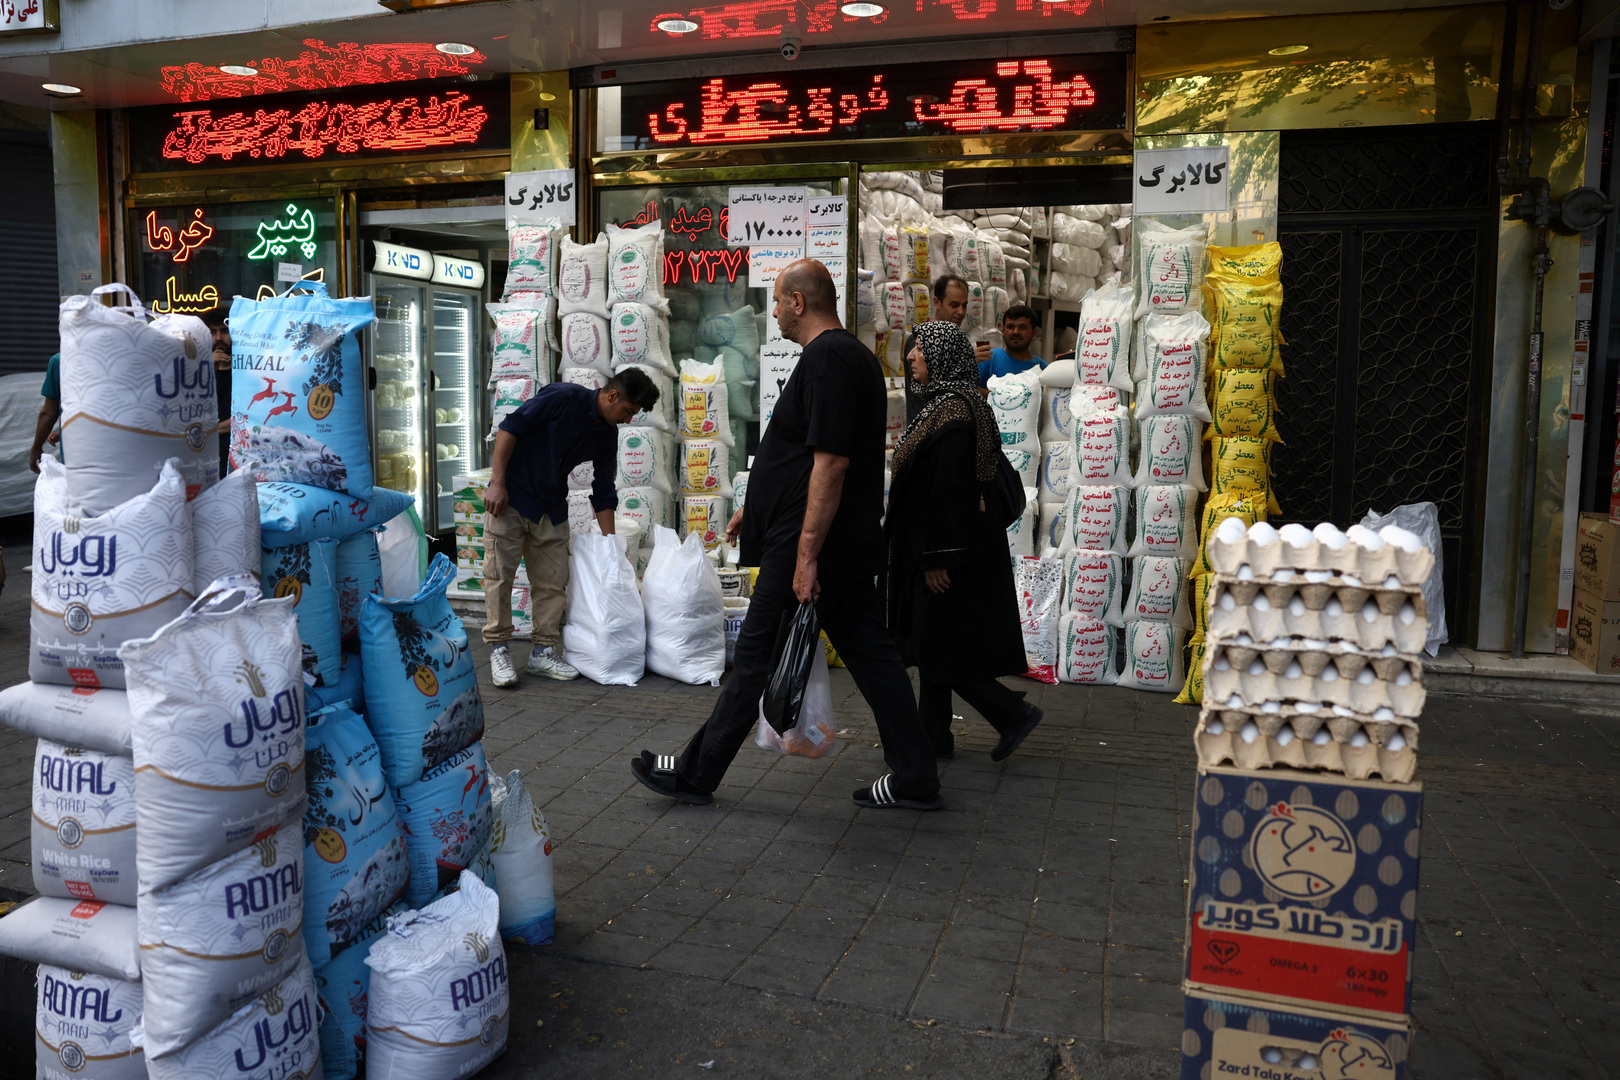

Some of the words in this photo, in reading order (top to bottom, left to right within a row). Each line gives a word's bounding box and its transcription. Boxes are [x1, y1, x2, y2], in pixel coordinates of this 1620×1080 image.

[1138, 161, 1226, 194] کالابرگ
[509, 182, 573, 211] کالابرگ
[732, 193, 762, 204] پاکستانی
[787, 193, 804, 204] برنج
[146, 208, 213, 262] خرما
[247, 203, 317, 259] پنیر
[751, 248, 774, 259] هاشمی
[774, 248, 790, 258] برنج
[790, 247, 802, 258] آرد
[151, 276, 219, 320] عسل
[1085, 324, 1112, 335] هاشمی
[1083, 339, 1094, 348] دوم
[1094, 337, 1111, 346] کشت
[1162, 343, 1192, 356] هاشمی
[1091, 352, 1108, 360] درجه
[1176, 356, 1192, 366] کشت
[231, 353, 286, 372] GHAZAL
[1161, 360, 1175, 369] دوم
[1235, 358, 1256, 367] شمال
[154, 356, 215, 400] رویال
[1172, 371, 1191, 380] درجه
[1231, 380, 1255, 393] معطر
[312, 394, 331, 410] 10
[1084, 417, 1113, 427] هاشمی
[1083, 430, 1095, 439] دوم
[1099, 428, 1113, 438] کشت
[1230, 424, 1251, 435] شمال
[1083, 443, 1093, 451] یک
[1094, 444, 1112, 452] درجه
[1233, 448, 1255, 460] معطر
[1082, 490, 1112, 500] هاشمی
[1081, 504, 1094, 513] دوم
[1095, 502, 1112, 513] کشت
[1081, 517, 1091, 525] یک
[1092, 519, 1111, 527] درجه
[40, 531, 117, 577] رویال
[1078, 559, 1108, 571] هاشمی
[1077, 575, 1090, 584] دوم
[1090, 573, 1107, 583] کشت
[1075, 586, 1087, 594] یک
[1088, 588, 1105, 597] درجه
[69, 614, 86, 624] BEST
[1076, 622, 1105, 635] هاشمی
[1075, 637, 1089, 647] دوم
[1089, 635, 1105, 644] کشت
[1075, 649, 1086, 657] یک
[1087, 649, 1104, 658] درجه
[223, 685, 300, 749] رویال
[40, 754, 116, 796] ROYAL
[42, 849, 77, 867] White
[79, 854, 111, 869] Rice
[63, 869, 86, 881] 386
[89, 869, 119, 878] ExpDate
[224, 859, 303, 920] ROYAL
[1202, 903, 1281, 932] کویر
[1289, 909, 1344, 939] طلا
[1350, 921, 1400, 951] زرد
[1269, 957, 1310, 973] OMEGA
[1311, 964, 1319, 974] 3
[450, 953, 508, 1012] ROYAL
[1366, 985, 1388, 998] egg
[42, 974, 123, 1024] ROYAL
[58, 1020, 89, 1040] MAN
[234, 992, 313, 1073] رویال
[1217, 1060, 1250, 1078] Zard
[1252, 1066, 1282, 1080] Tala
